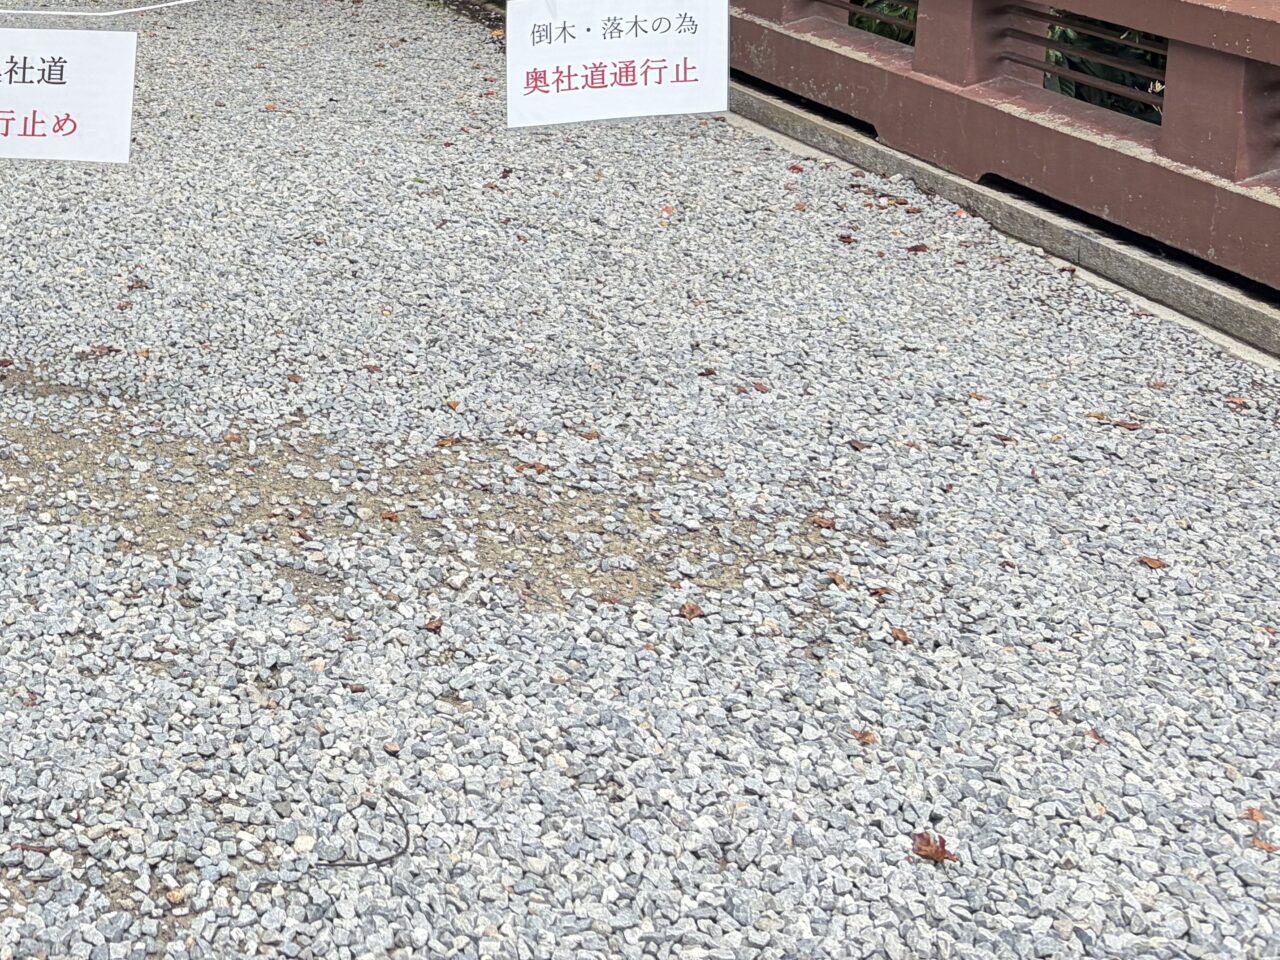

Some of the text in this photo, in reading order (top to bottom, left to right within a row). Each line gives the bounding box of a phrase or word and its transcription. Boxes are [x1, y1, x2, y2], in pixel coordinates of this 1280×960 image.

[530, 12, 699, 47] 倒木・落木の為
[523, 56, 699, 97] 奥社道通行止
